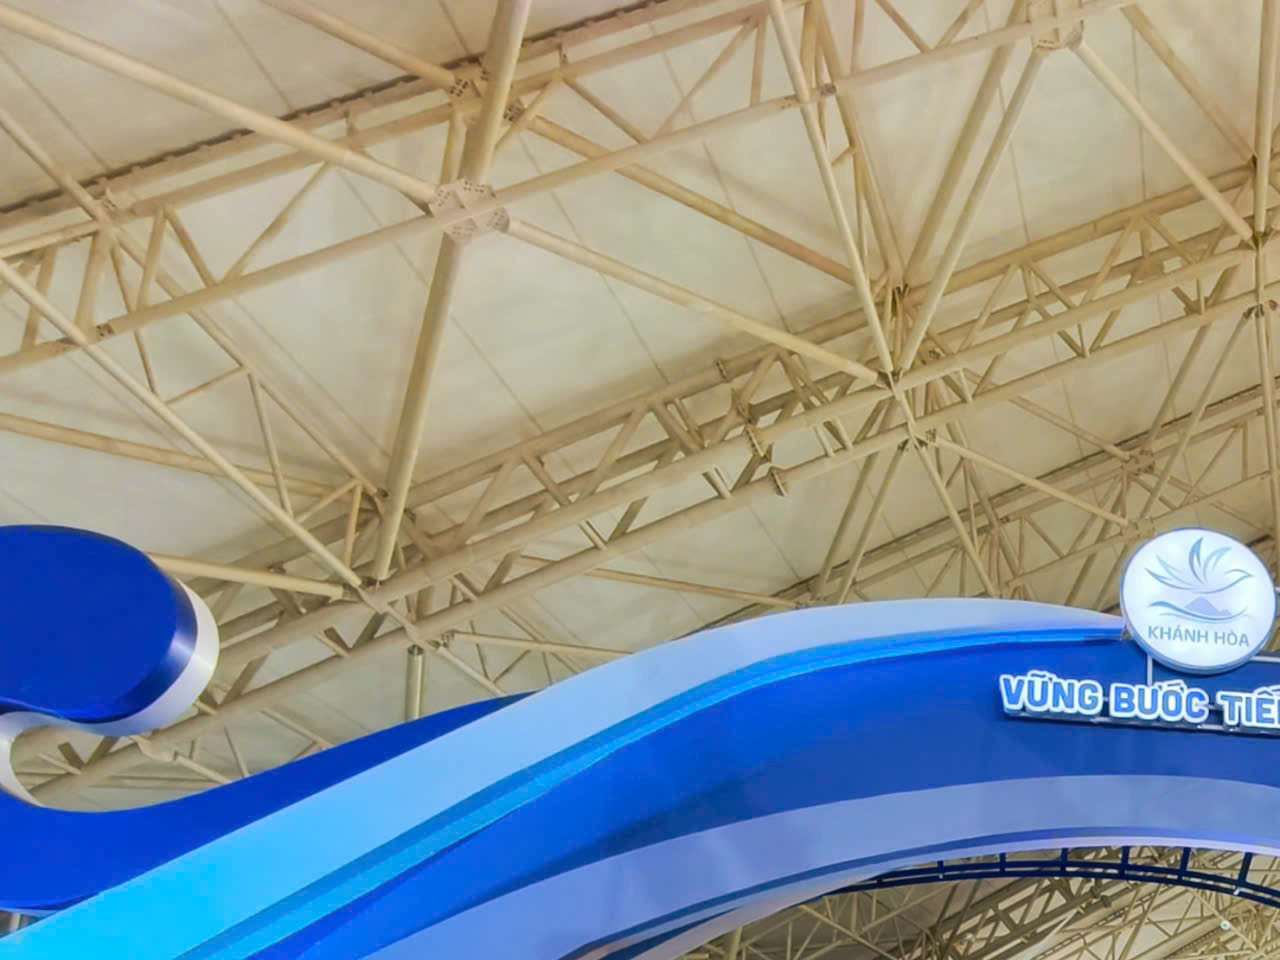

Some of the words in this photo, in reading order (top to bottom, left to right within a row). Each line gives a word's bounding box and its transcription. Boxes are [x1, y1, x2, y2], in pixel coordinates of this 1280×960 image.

[1148, 625, 1209, 644] KHÁNH
[1214, 629, 1249, 646] HÒA
[1000, 670, 1104, 715] VỮNG
[1109, 680, 1210, 724] BƯỚC
